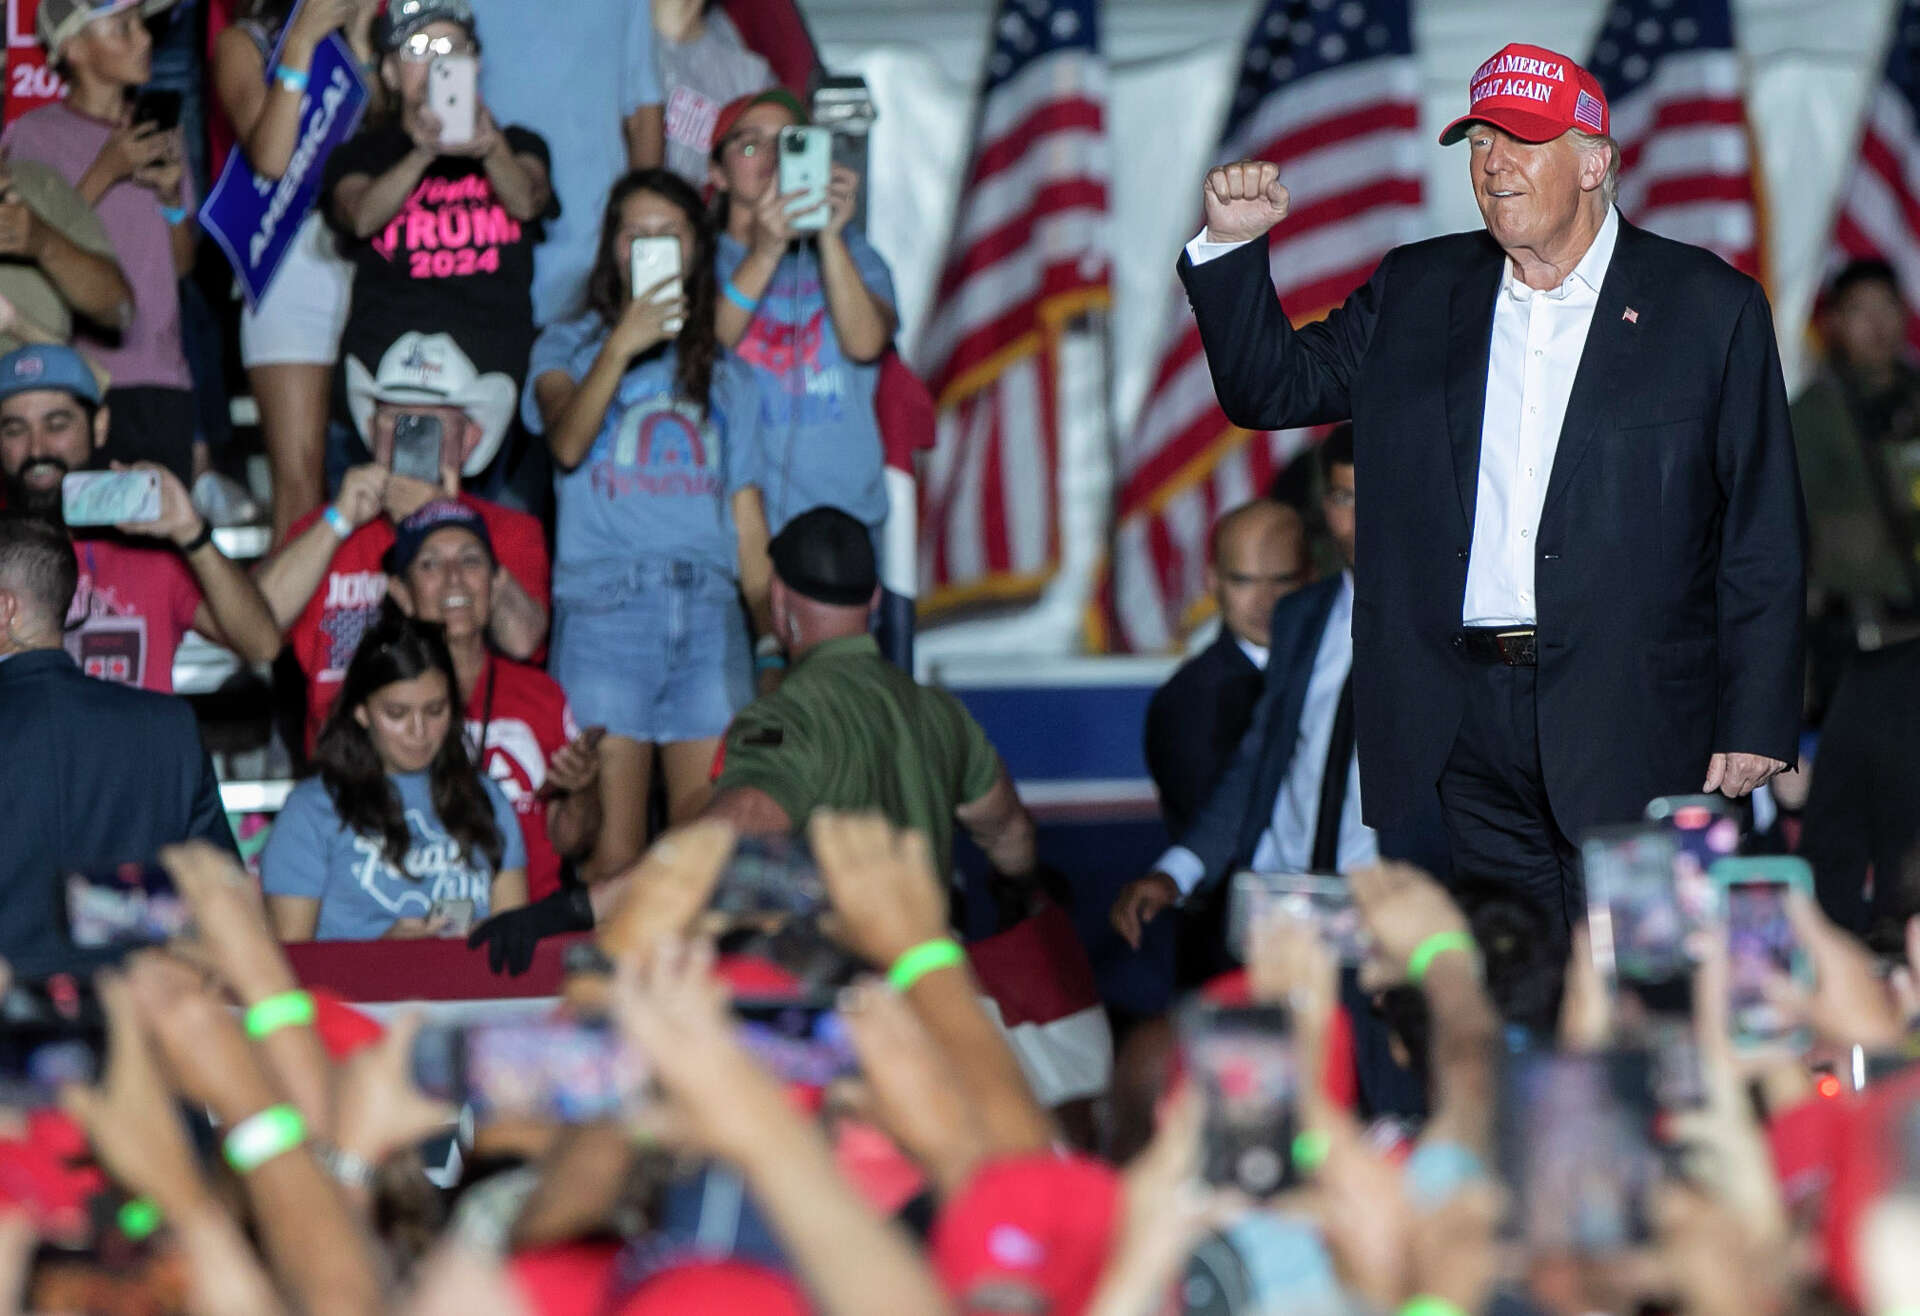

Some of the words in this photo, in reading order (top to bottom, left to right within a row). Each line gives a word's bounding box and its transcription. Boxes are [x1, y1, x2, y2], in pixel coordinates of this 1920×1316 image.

[12, 63, 70, 98] 20
[1495, 55, 1565, 82] AMERICA
[1471, 79, 1502, 106] REAT
[1500, 78, 1554, 103] AGAIN
[409, 247, 500, 279] 2024
